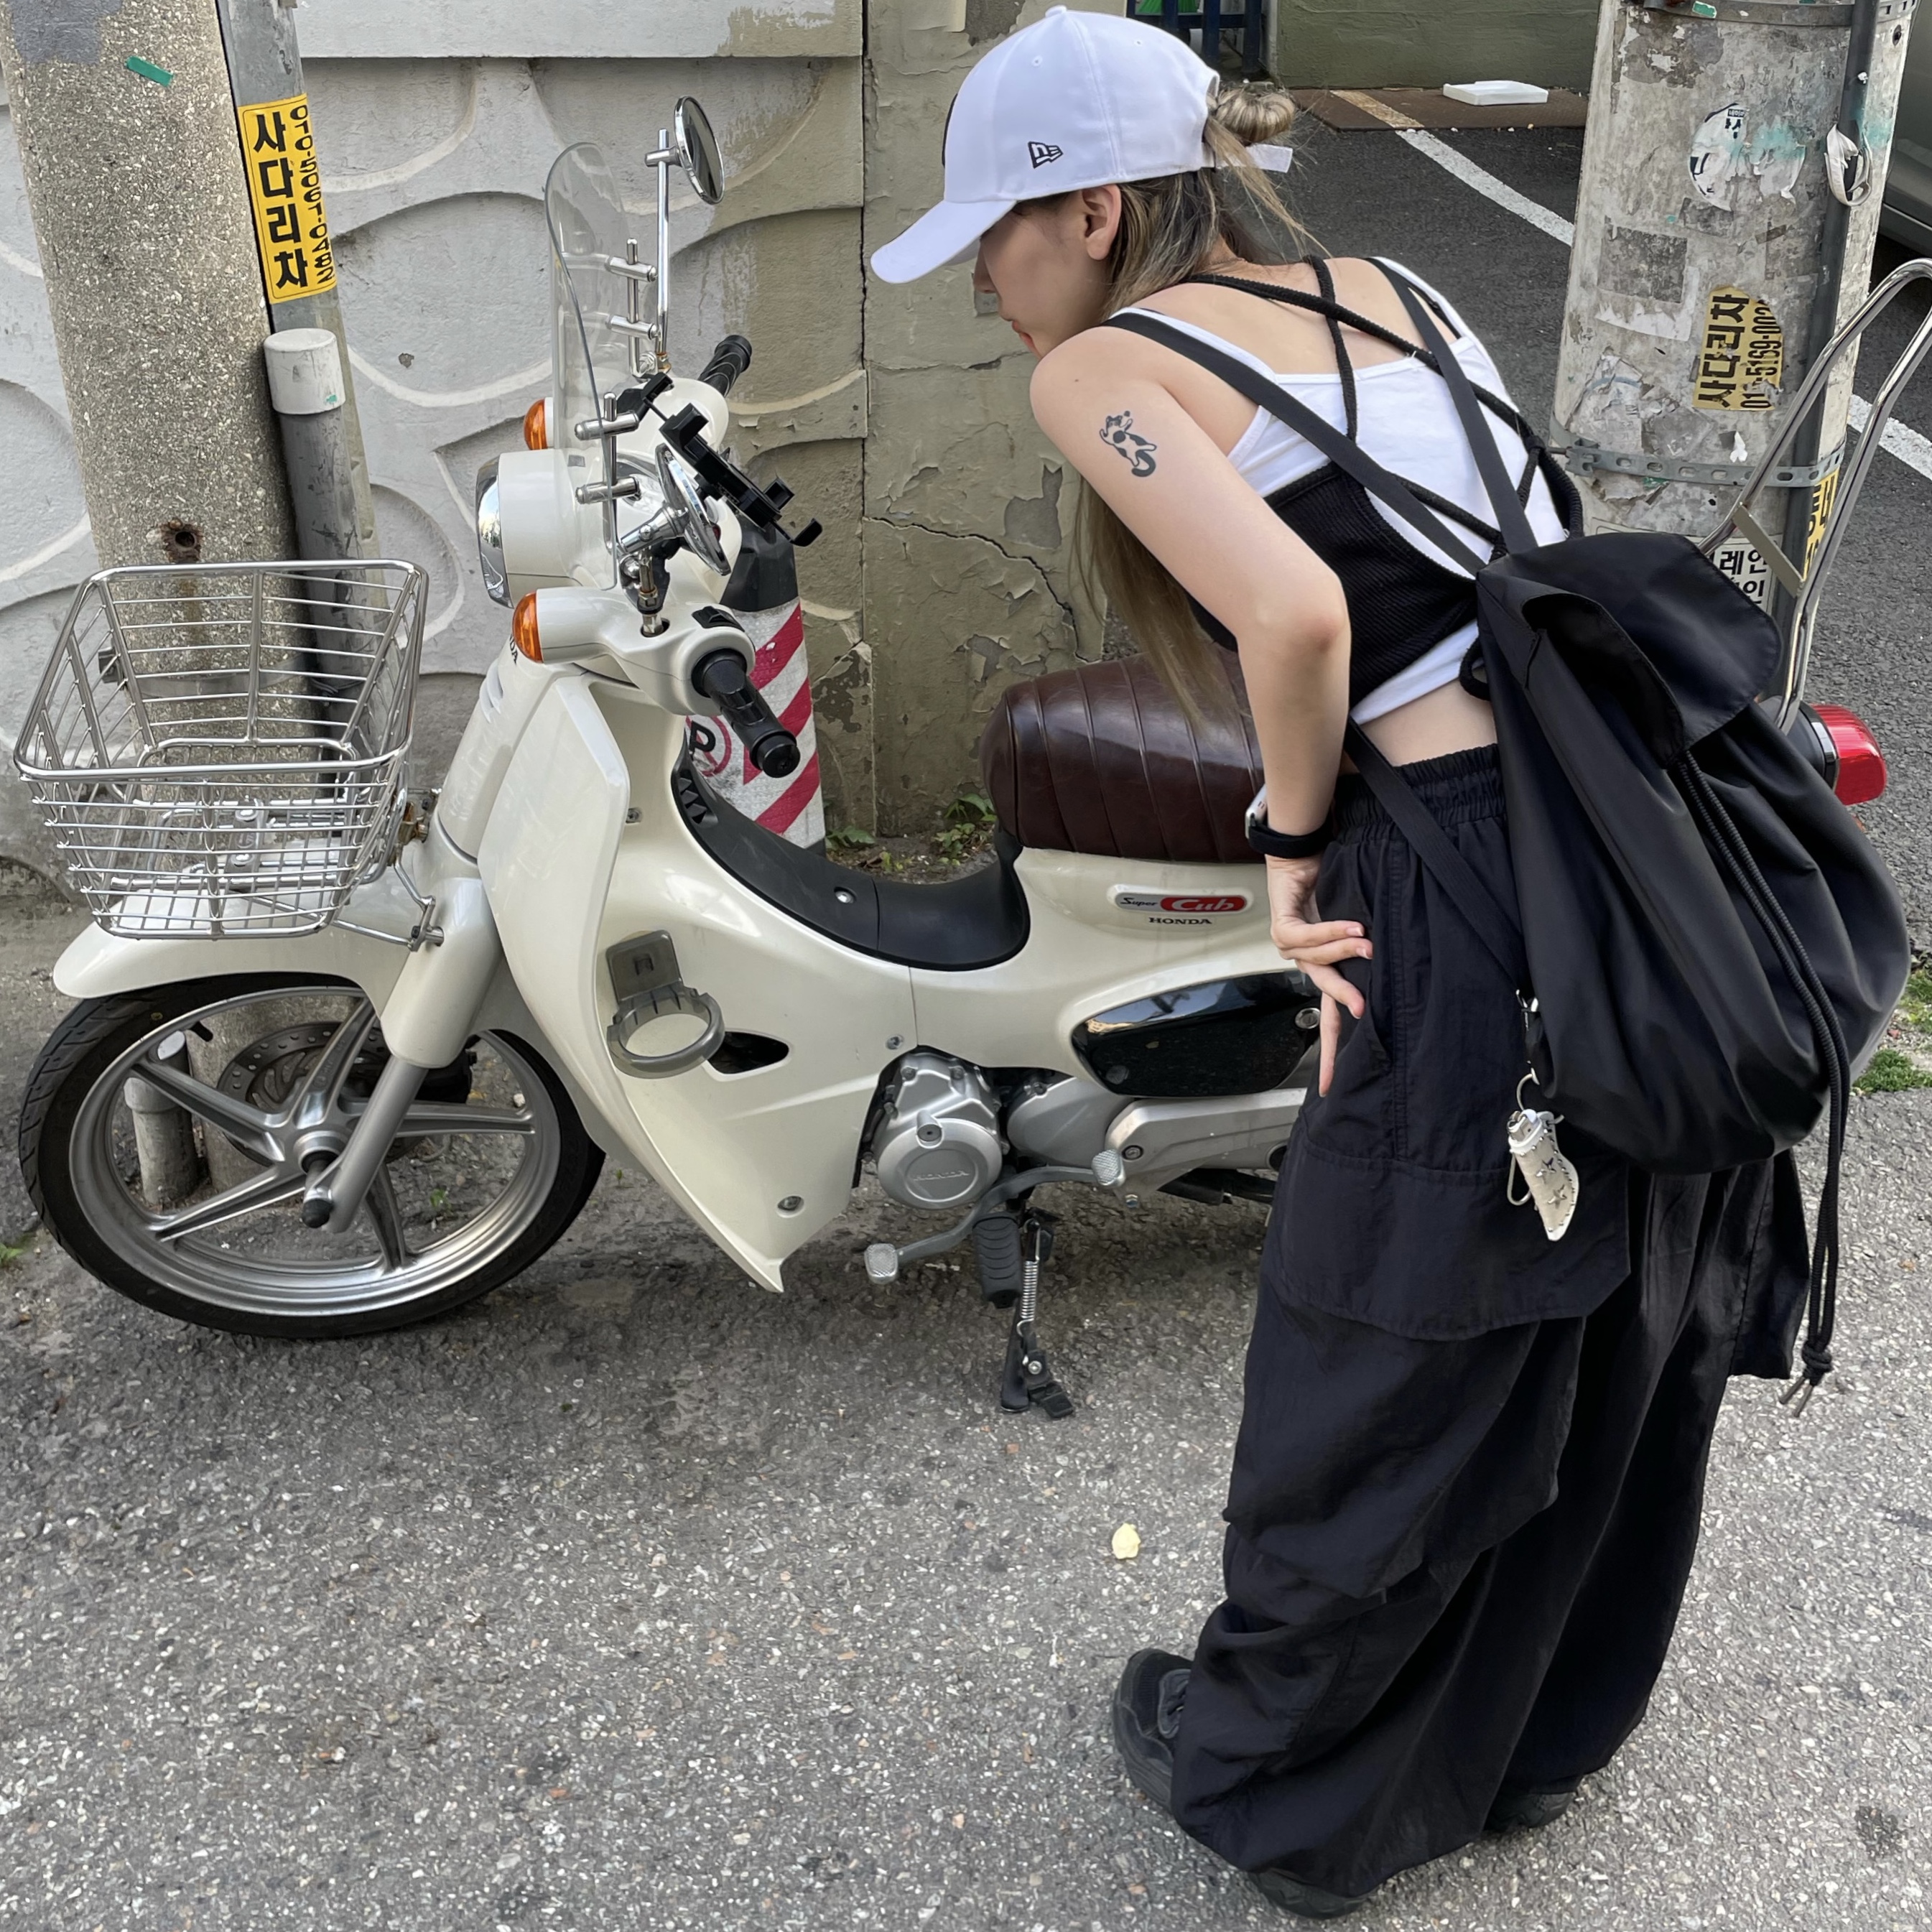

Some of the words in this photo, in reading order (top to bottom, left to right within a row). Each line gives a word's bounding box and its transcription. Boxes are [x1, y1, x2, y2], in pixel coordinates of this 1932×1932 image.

[254, 111, 307, 289] 사다리차
[1698, 294, 1750, 407] 사다리차
[1740, 299, 1782, 409] 01-5169-002
[1120, 897, 1158, 906] Super
[1171, 898, 1235, 911] Cub
[1149, 916, 1212, 925] HONDA
